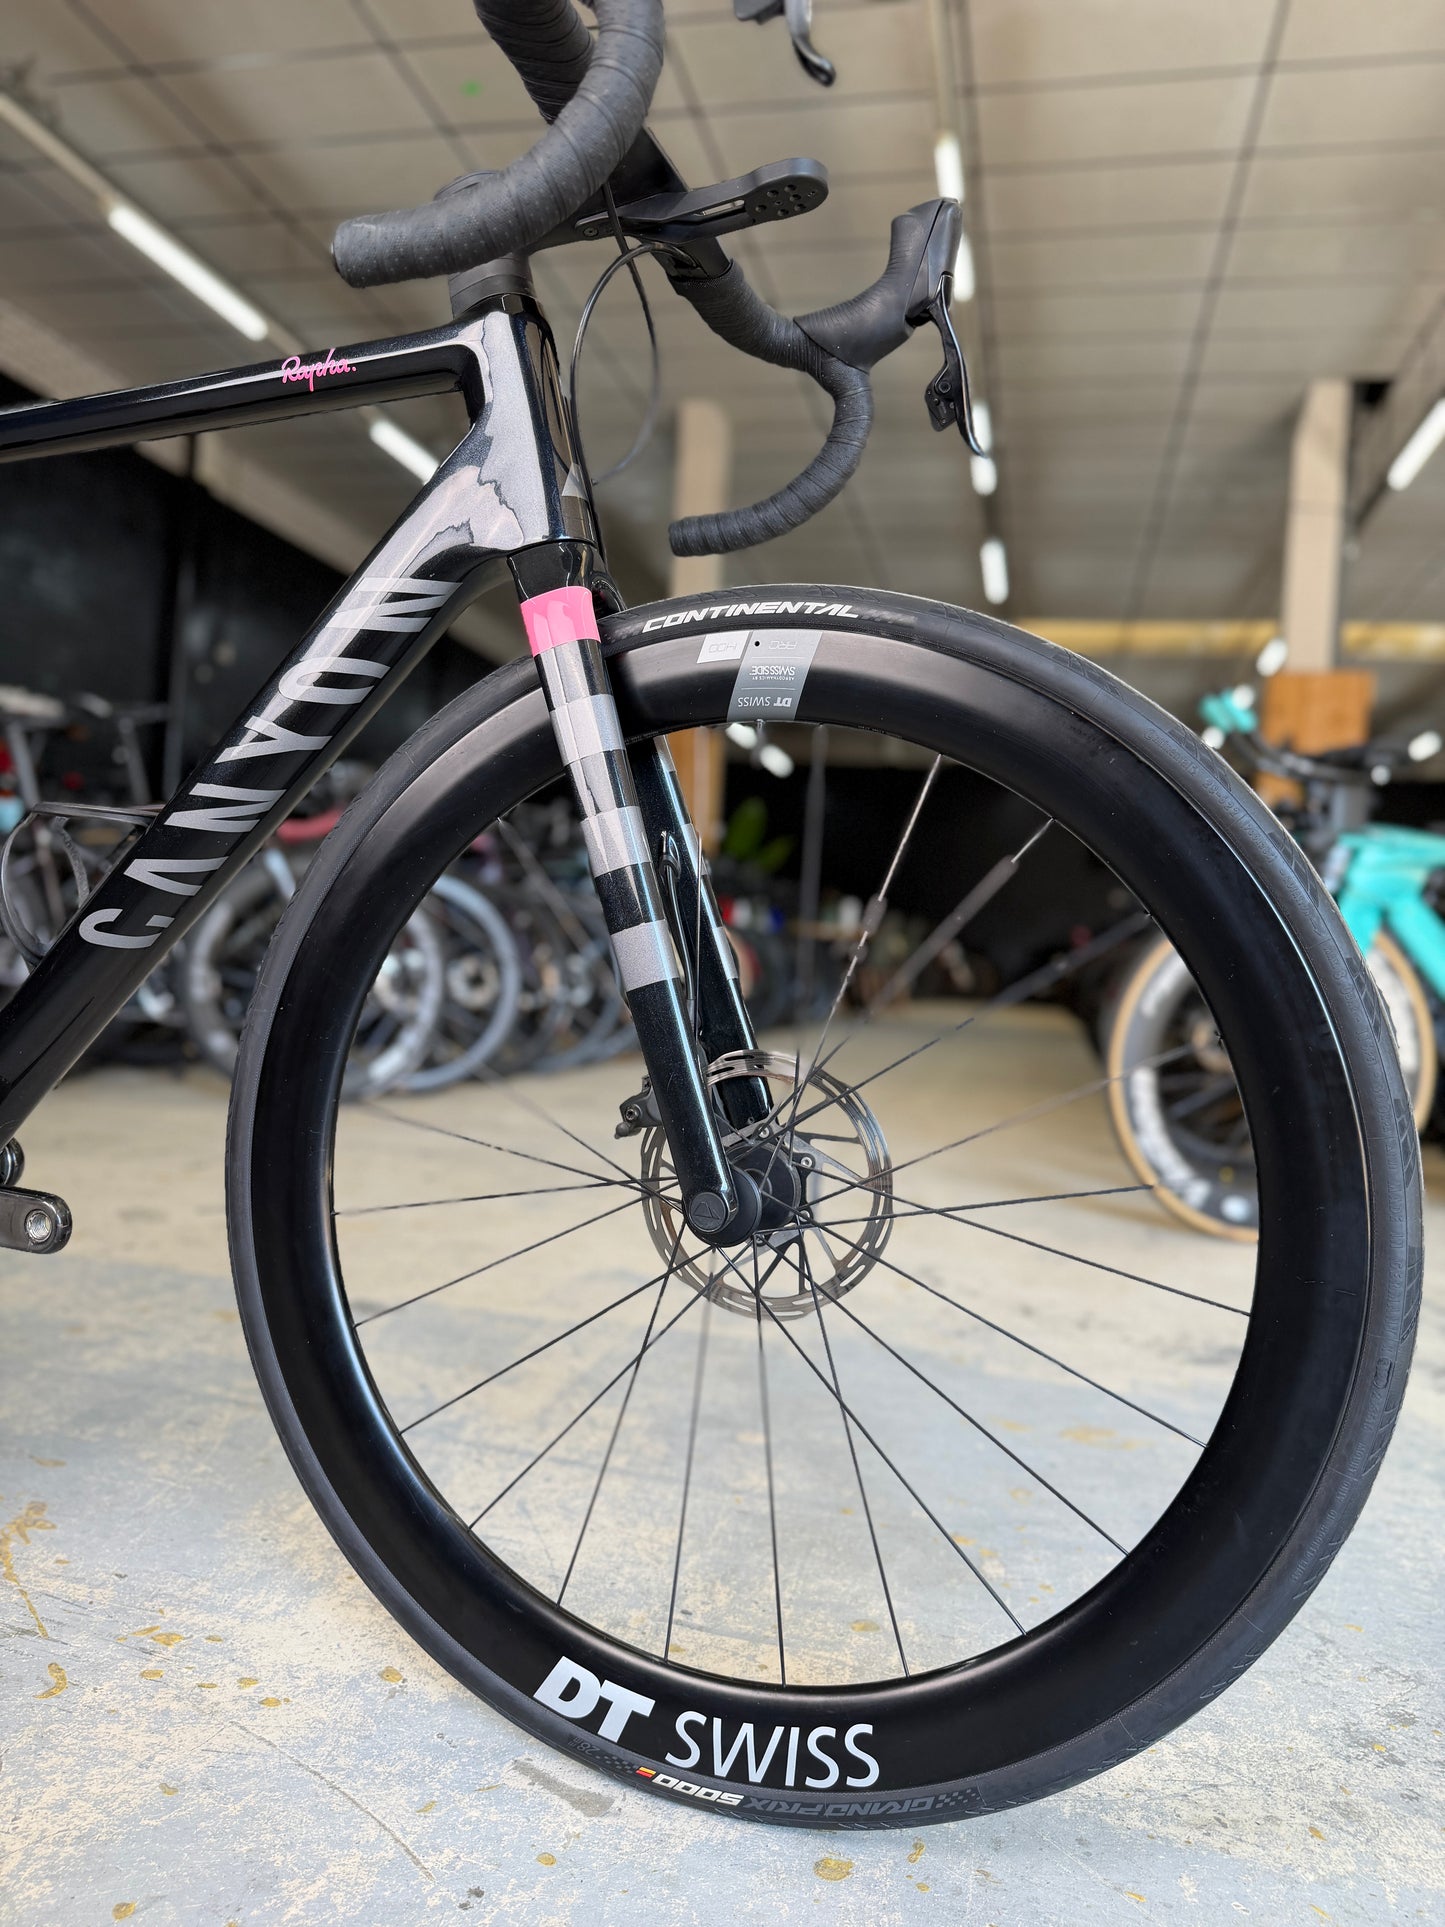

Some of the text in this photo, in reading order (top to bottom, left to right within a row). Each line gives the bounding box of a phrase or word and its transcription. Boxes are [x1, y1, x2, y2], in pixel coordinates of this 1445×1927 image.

[641, 601, 859, 633] CONTINENTAL
[737, 697, 792, 708] DT SWISS
[79, 577, 463, 949] CANYON
[533, 1656, 880, 1789] DT SWISS
[651, 1773, 745, 1806] 5000
